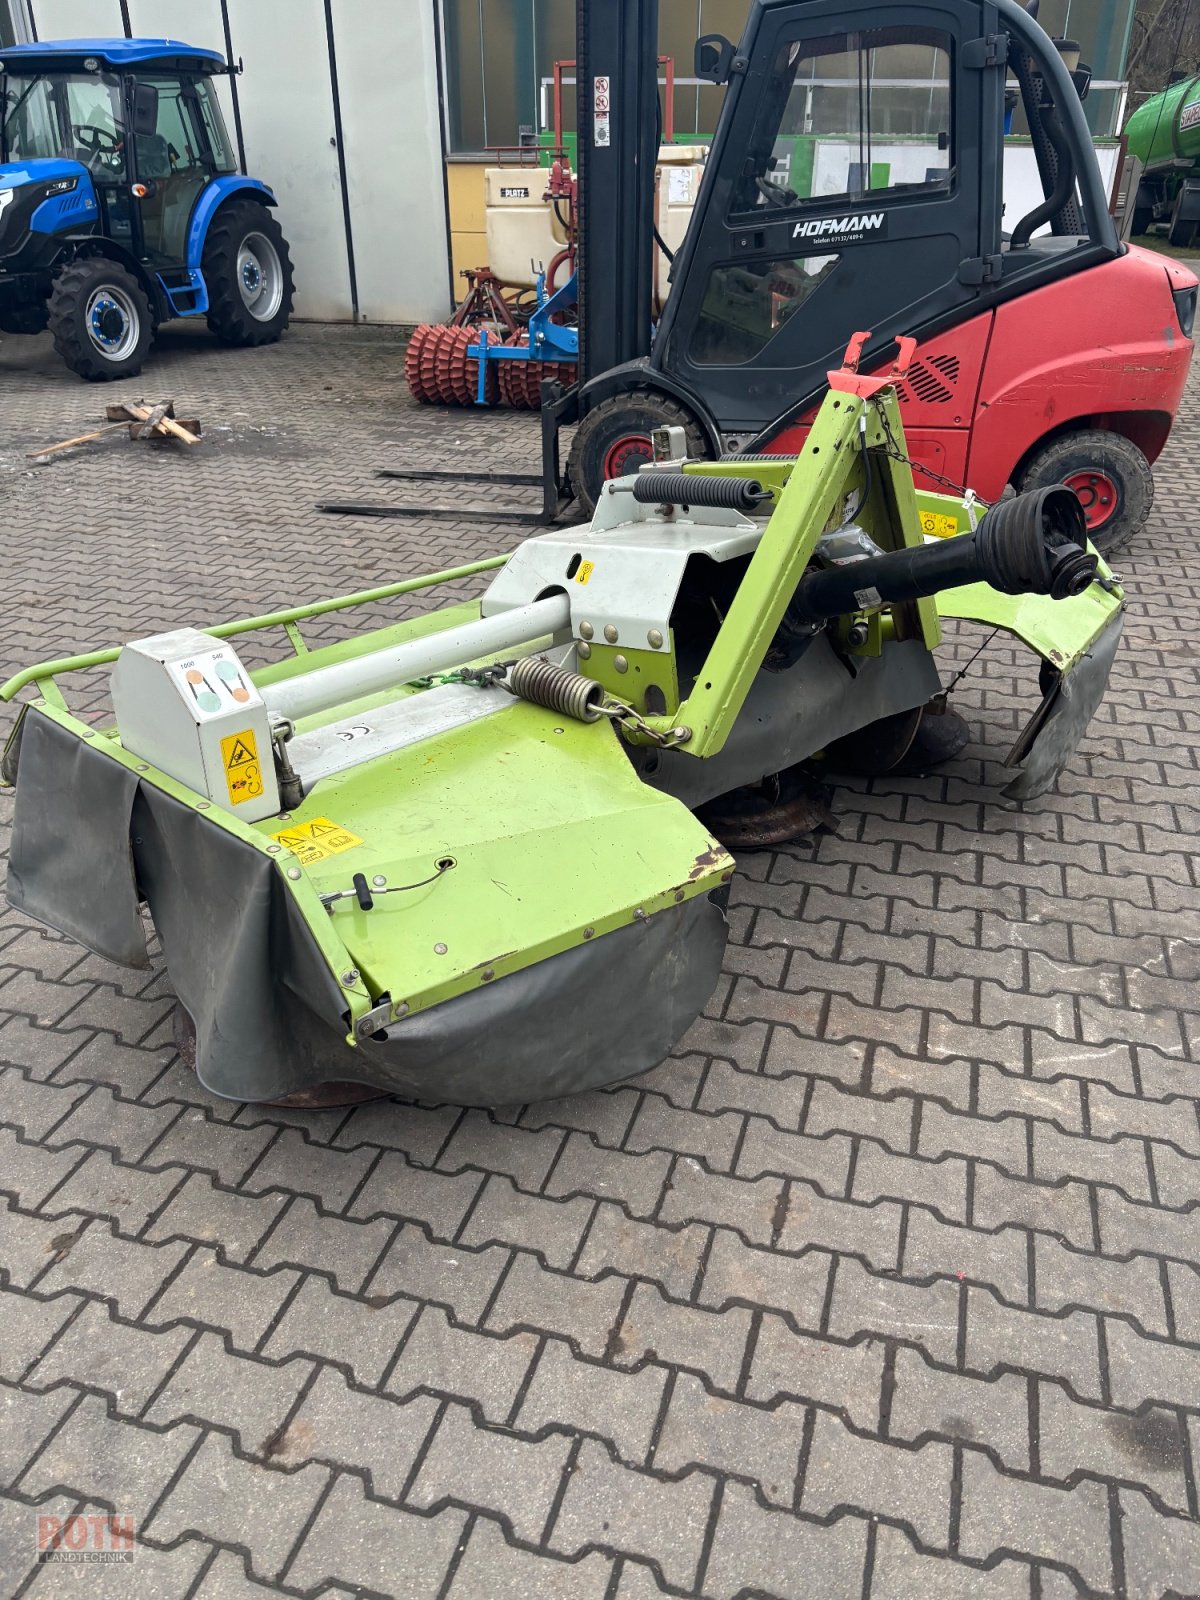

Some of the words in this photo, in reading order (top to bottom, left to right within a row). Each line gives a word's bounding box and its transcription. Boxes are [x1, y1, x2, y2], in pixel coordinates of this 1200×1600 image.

[505, 189, 525, 197] PLATZ
[792, 213, 884, 238] HOFMANN
[180, 661, 195, 669] 1000
